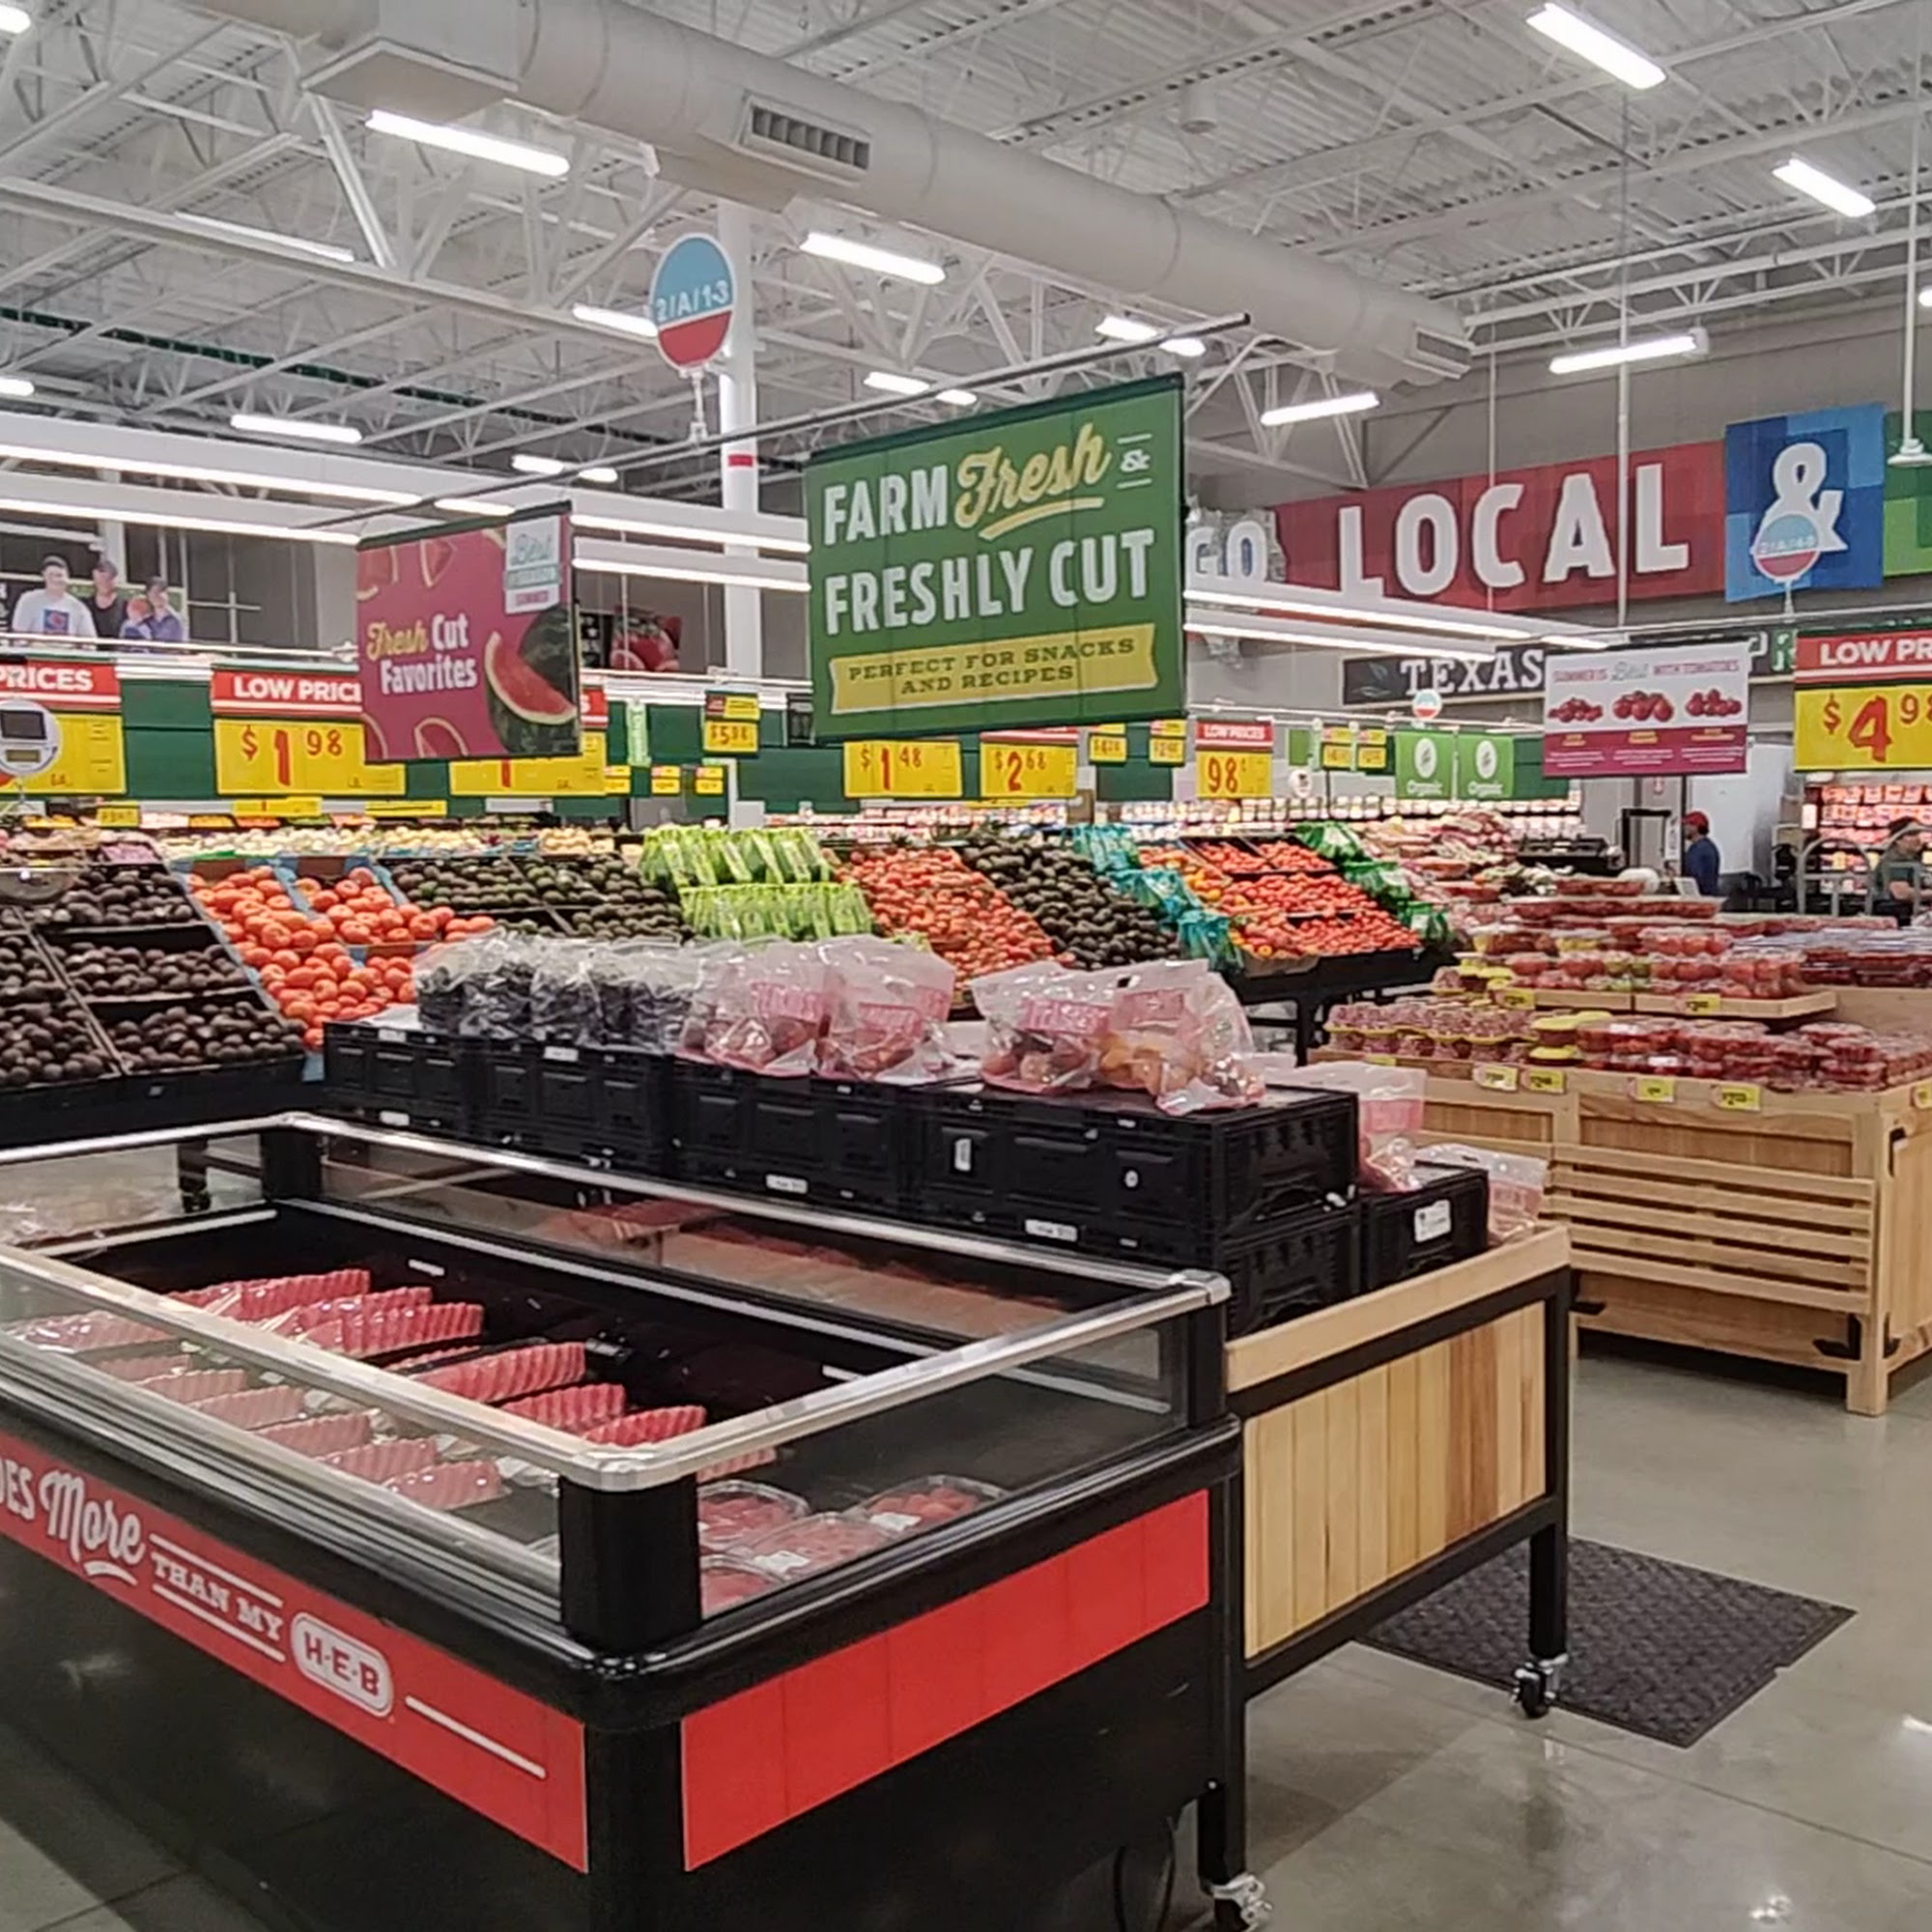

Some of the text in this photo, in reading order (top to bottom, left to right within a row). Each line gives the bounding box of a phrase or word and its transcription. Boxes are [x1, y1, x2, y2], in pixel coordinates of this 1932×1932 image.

[823, 423, 1151, 546] FARM Fresh &
[1339, 463, 1690, 599] LOCAL
[1749, 441, 1849, 556] &
[825, 528, 1155, 636] FRESHLY CUT
[366, 612, 469, 662] Fresh Cut
[848, 638, 1135, 681] PERFECT FOR SNACKS
[1821, 639, 1890, 667] LOW
[0, 665, 94, 692] RICES
[233, 675, 296, 699] LOW
[380, 654, 479, 695] Favorites
[900, 666, 1074, 696] AND RECIPES
[1400, 649, 1546, 696] TEXAS
[39, 1470, 147, 1564] More
[151, 1551, 230, 1612] THAN
[237, 1597, 283, 1642] MY
